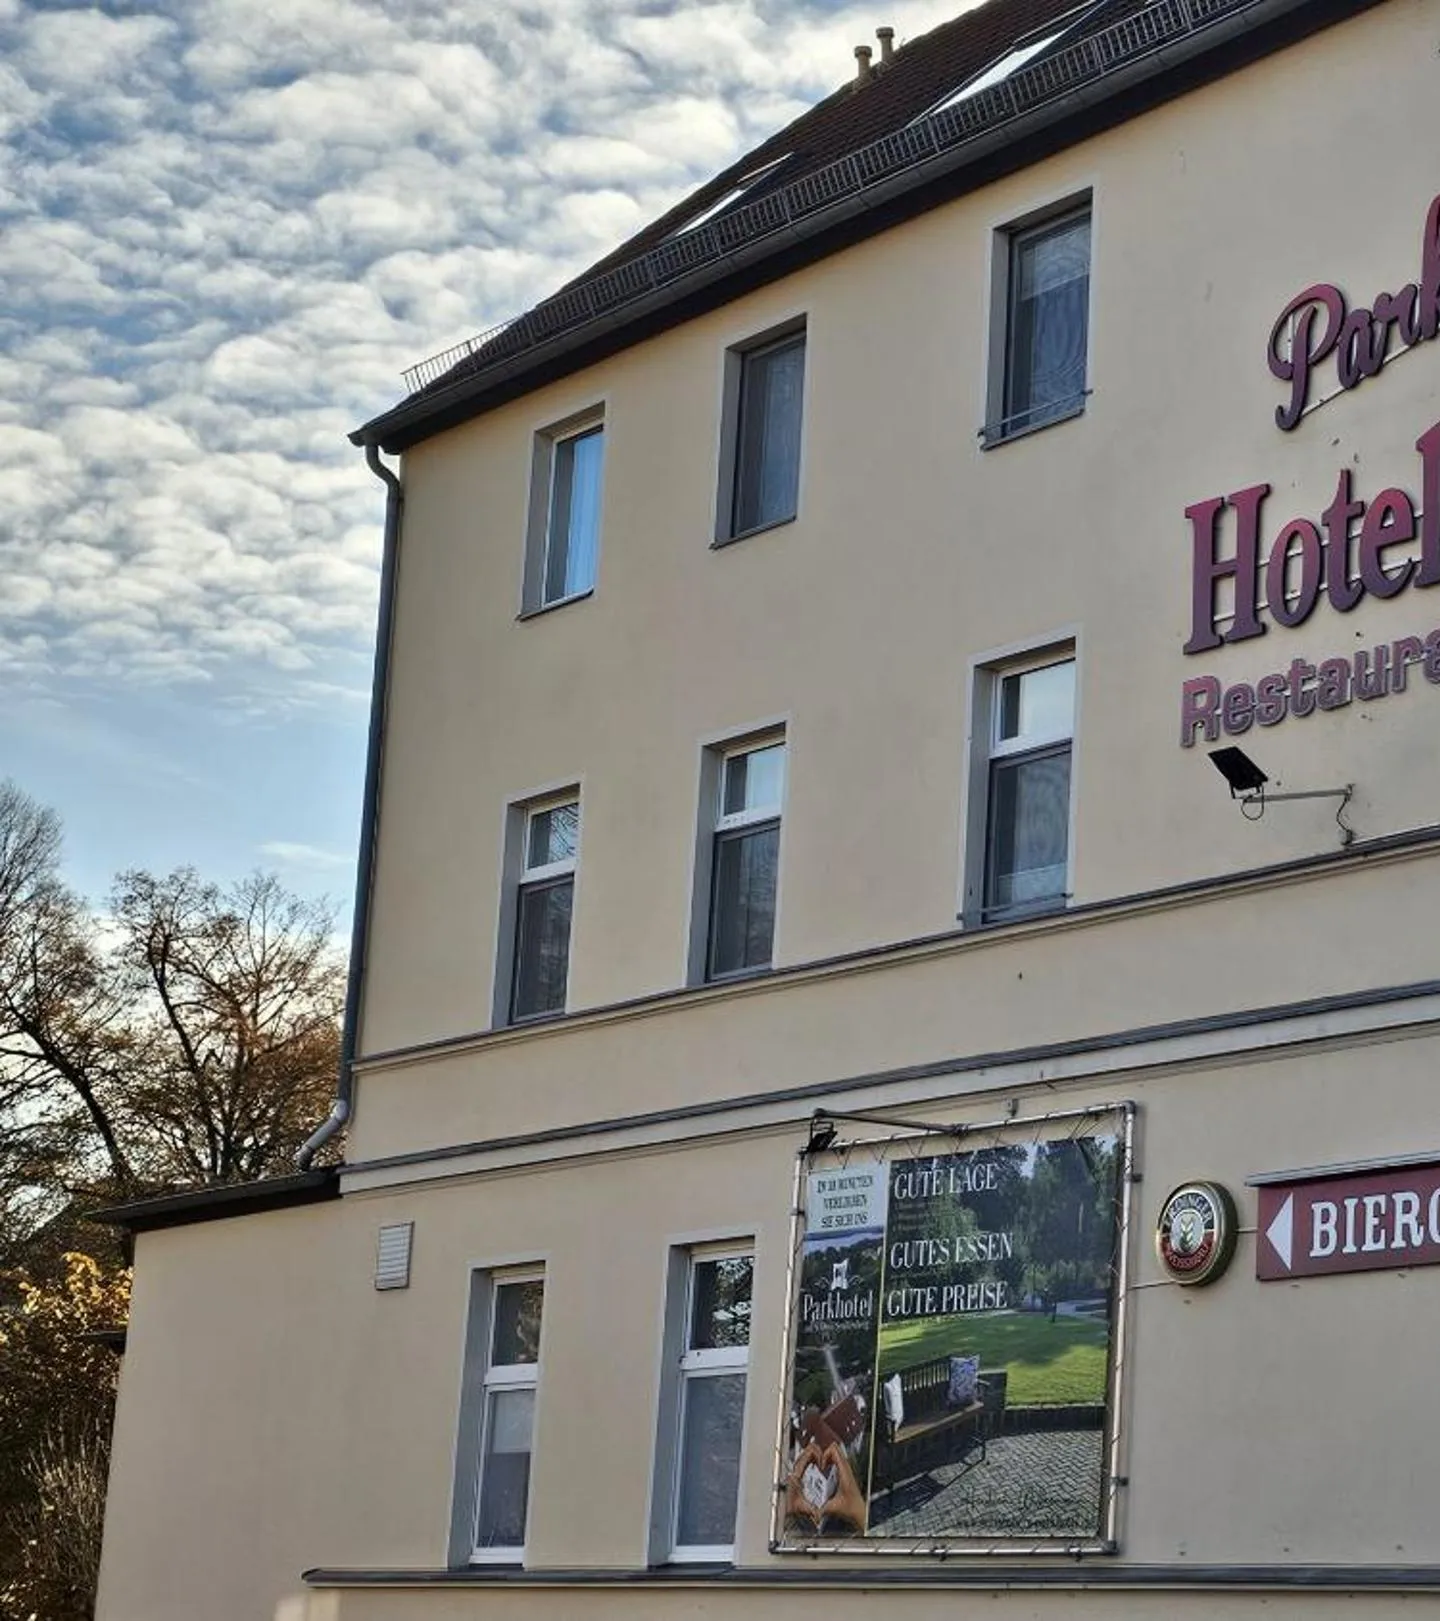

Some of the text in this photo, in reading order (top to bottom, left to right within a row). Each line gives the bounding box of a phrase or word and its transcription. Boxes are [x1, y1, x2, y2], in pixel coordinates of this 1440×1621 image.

[894, 1163, 999, 1200] GUTE LAGE
[890, 1231, 1013, 1269] GUTES ESSEN
[803, 1290, 873, 1321] Parkhotel
[887, 1280, 1008, 1317] GUTE PREISE
